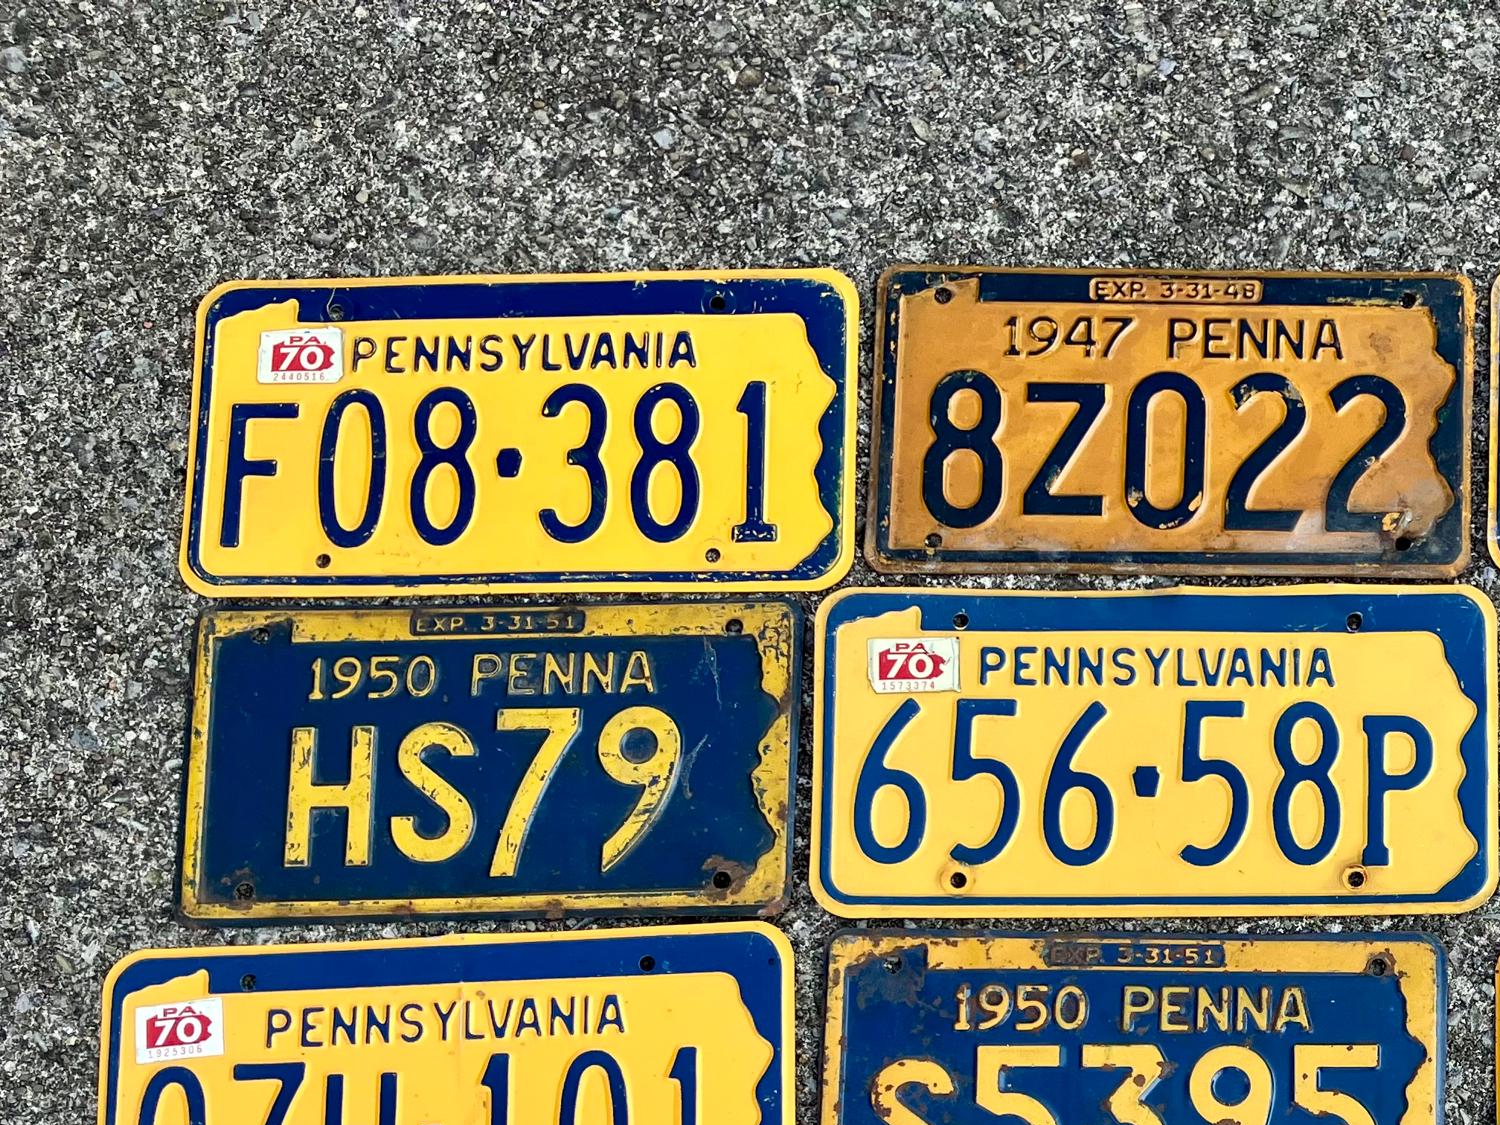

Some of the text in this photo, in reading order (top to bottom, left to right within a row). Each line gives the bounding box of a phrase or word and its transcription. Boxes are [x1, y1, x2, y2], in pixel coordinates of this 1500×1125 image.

[1160, 281, 1255, 299] 3-31-48
[352, 331, 696, 373] PENNSYLVANIA
[1004, 316, 1343, 361] 1947 PENNA
[280, 346, 325, 371] 70
[273, 372, 326, 382] 2440516
[922, 370, 1408, 533] 8Z022
[480, 615, 574, 631] 3-31-51
[309, 651, 656, 700] 1950 PENNA
[886, 654, 934, 680] 70
[980, 646, 1336, 687] PENNSYLVANIA
[882, 681, 935, 690] 1573374
[284, 706, 682, 877] HS79
[1117, 947, 1215, 964] 3-31-51
[267, 994, 626, 1048] PENNSYLVANIA
[955, 984, 1313, 1032] 1950 PENNA
[155, 1016, 202, 1046] 70
[148, 1046, 203, 1058] 1925306
